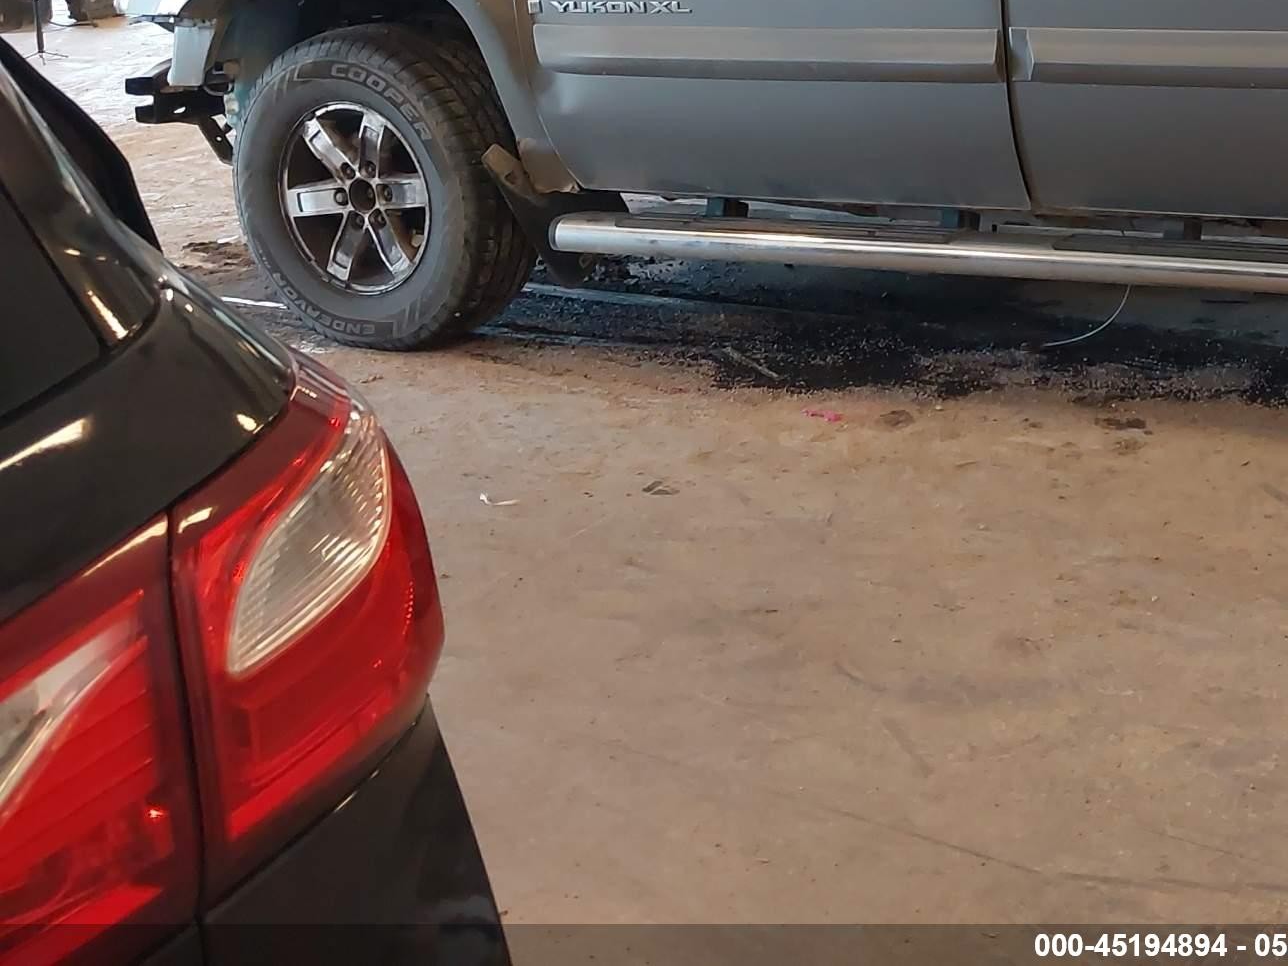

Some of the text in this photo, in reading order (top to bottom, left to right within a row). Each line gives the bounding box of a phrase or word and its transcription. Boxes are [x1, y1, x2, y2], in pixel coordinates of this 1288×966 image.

[550, 0, 692, 14] YUKON XL
[331, 64, 432, 140] COOPER
[272, 272, 376, 335] ENDEAVOR
